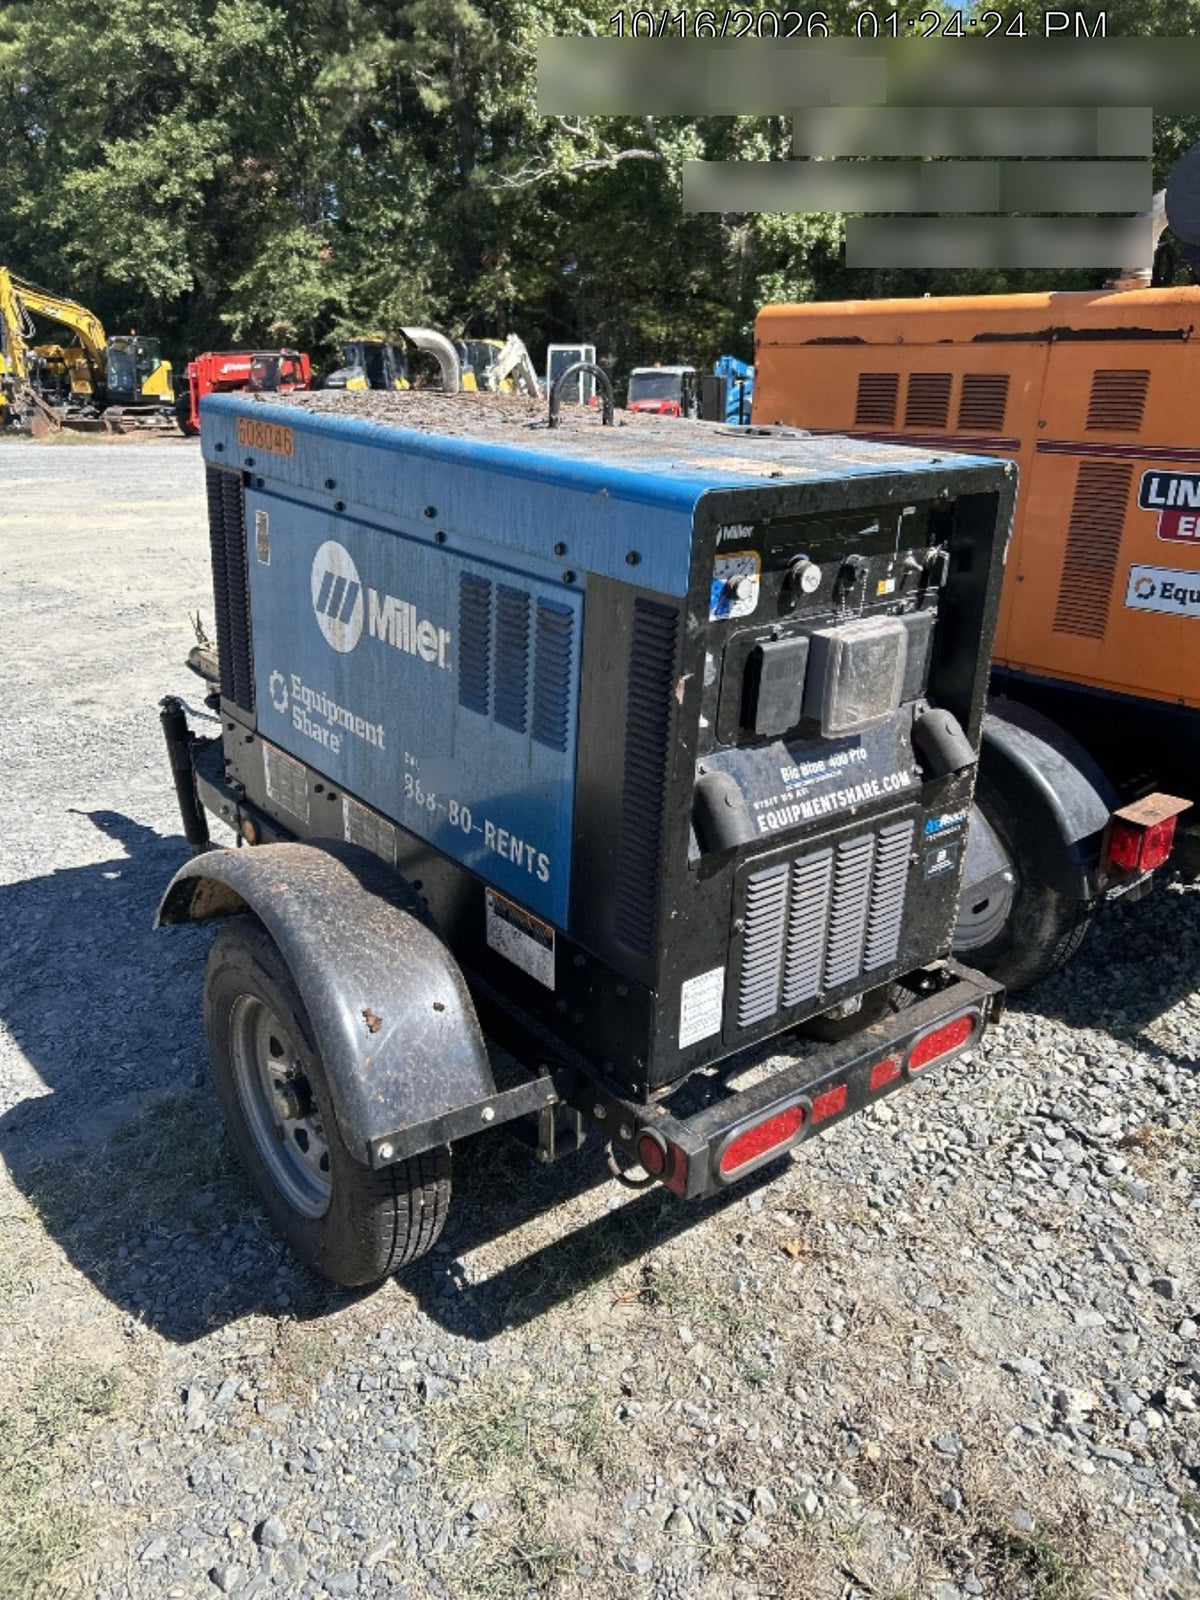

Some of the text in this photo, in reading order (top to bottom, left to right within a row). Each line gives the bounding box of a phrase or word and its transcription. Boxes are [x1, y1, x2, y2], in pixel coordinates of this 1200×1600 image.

[723, 523, 754, 541] Miller
[368, 588, 451, 670] Miller
[291, 673, 385, 751] Equipment
[293, 705, 340, 754] Share
[756, 770, 911, 833] EQUIPMENTSHARE.COM
